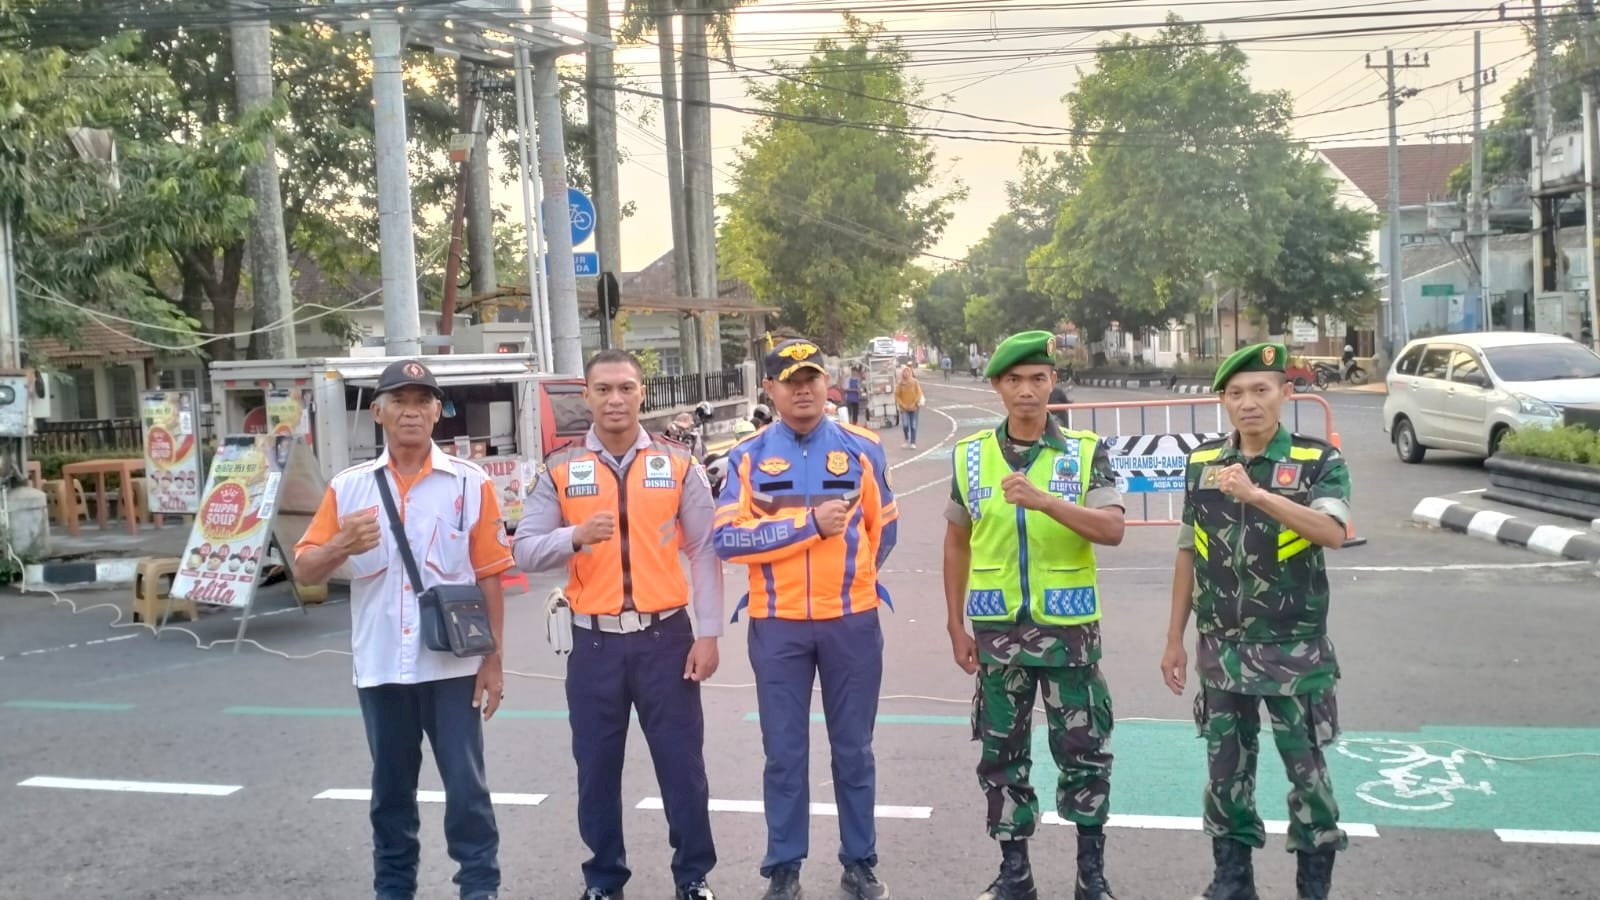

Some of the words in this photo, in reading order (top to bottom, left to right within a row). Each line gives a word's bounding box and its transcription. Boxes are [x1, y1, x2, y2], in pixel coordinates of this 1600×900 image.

[1111, 456, 1131, 469] ATUHI
[206, 513, 236, 526] SOUP
[723, 525, 789, 547] DISHUB
